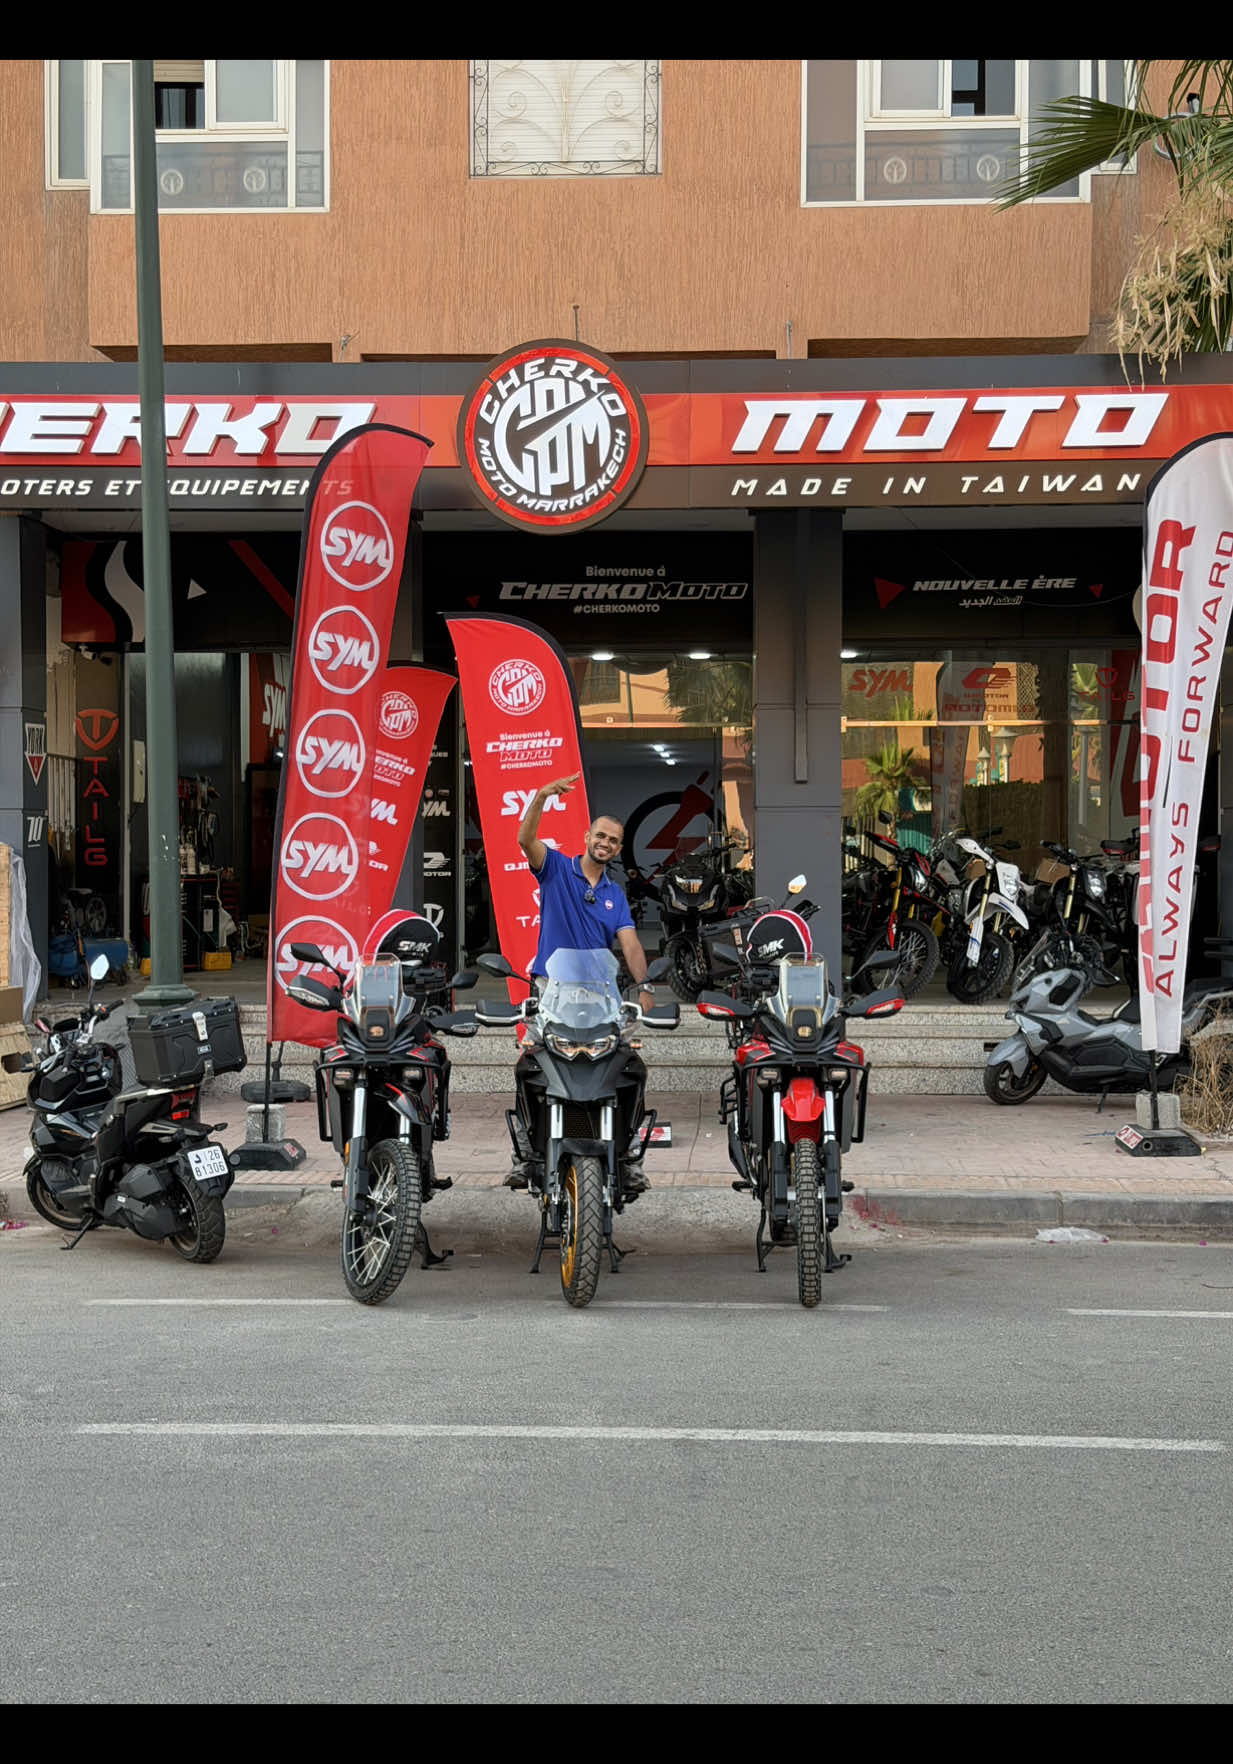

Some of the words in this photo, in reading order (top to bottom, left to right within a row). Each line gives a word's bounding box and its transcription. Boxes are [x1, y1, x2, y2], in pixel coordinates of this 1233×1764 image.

[479, 358, 627, 425] CHERKO
[0, 401, 376, 456] ERKO
[731, 393, 1169, 454] MOTO
[477, 437, 518, 497] MOTO
[516, 428, 627, 512] MARRAKECH
[105, 479, 142, 496] ET
[164, 479, 354, 497] QUIPEMETS
[731, 477, 852, 496] MADE
[882, 476, 927, 494] IN
[960, 473, 1141, 494] TAIWAN
[324, 526, 392, 569] SYM
[585, 565, 655, 577] Bienvenue
[912, 578, 1030, 592] NOUVELLE
[573, 603, 660, 614] #CHERKOMOTO
[311, 631, 376, 671] SYM
[848, 669, 914, 699] SYM
[299, 734, 363, 775] SYM
[486, 737, 563, 753] CHERKO
[83, 757, 109, 866] TAILG
[421, 800, 451, 818] YM
[284, 842, 356, 878] SYM
[1155, 802, 1190, 999] ALWAYS
[515, 915, 541, 928] TA
[397, 940, 432, 953] SMK
[757, 938, 785, 956] SMK
[194, 1161, 226, 1177] 81306
